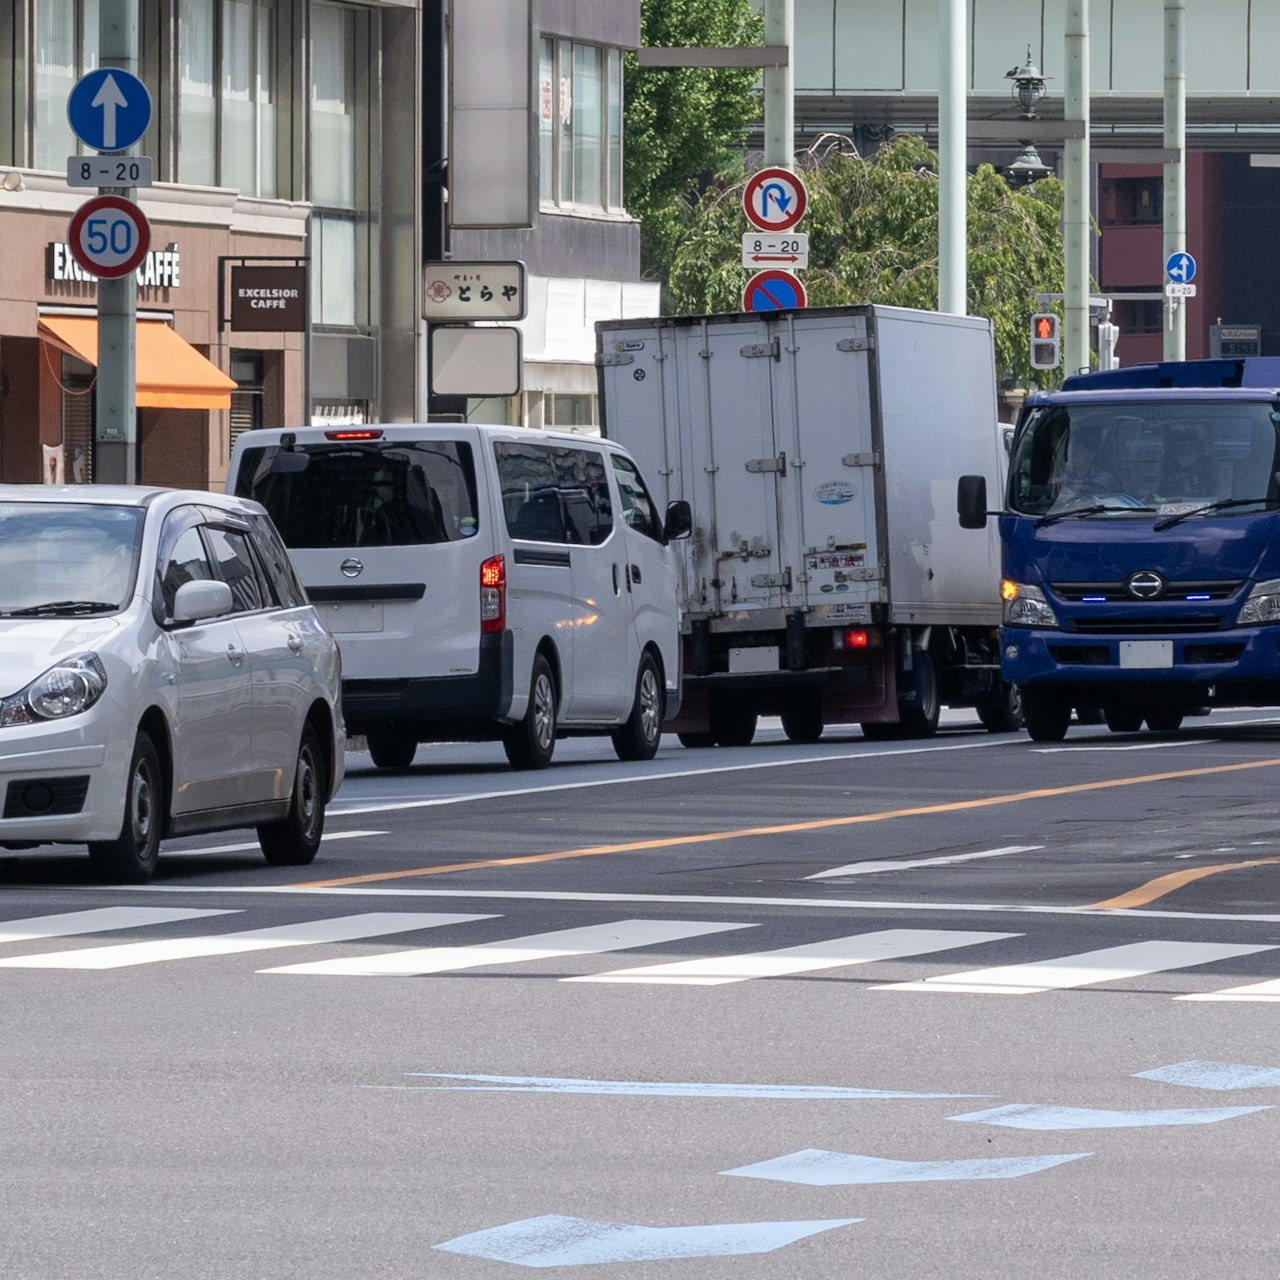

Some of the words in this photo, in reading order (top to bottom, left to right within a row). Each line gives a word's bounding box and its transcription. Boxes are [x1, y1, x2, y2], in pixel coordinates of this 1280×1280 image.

[86, 219, 132, 255] 50
[238, 288, 299, 299] EXCELSIOR
[458, 284, 518, 303] とらや
[250, 298, 287, 310] CAFFÉ
